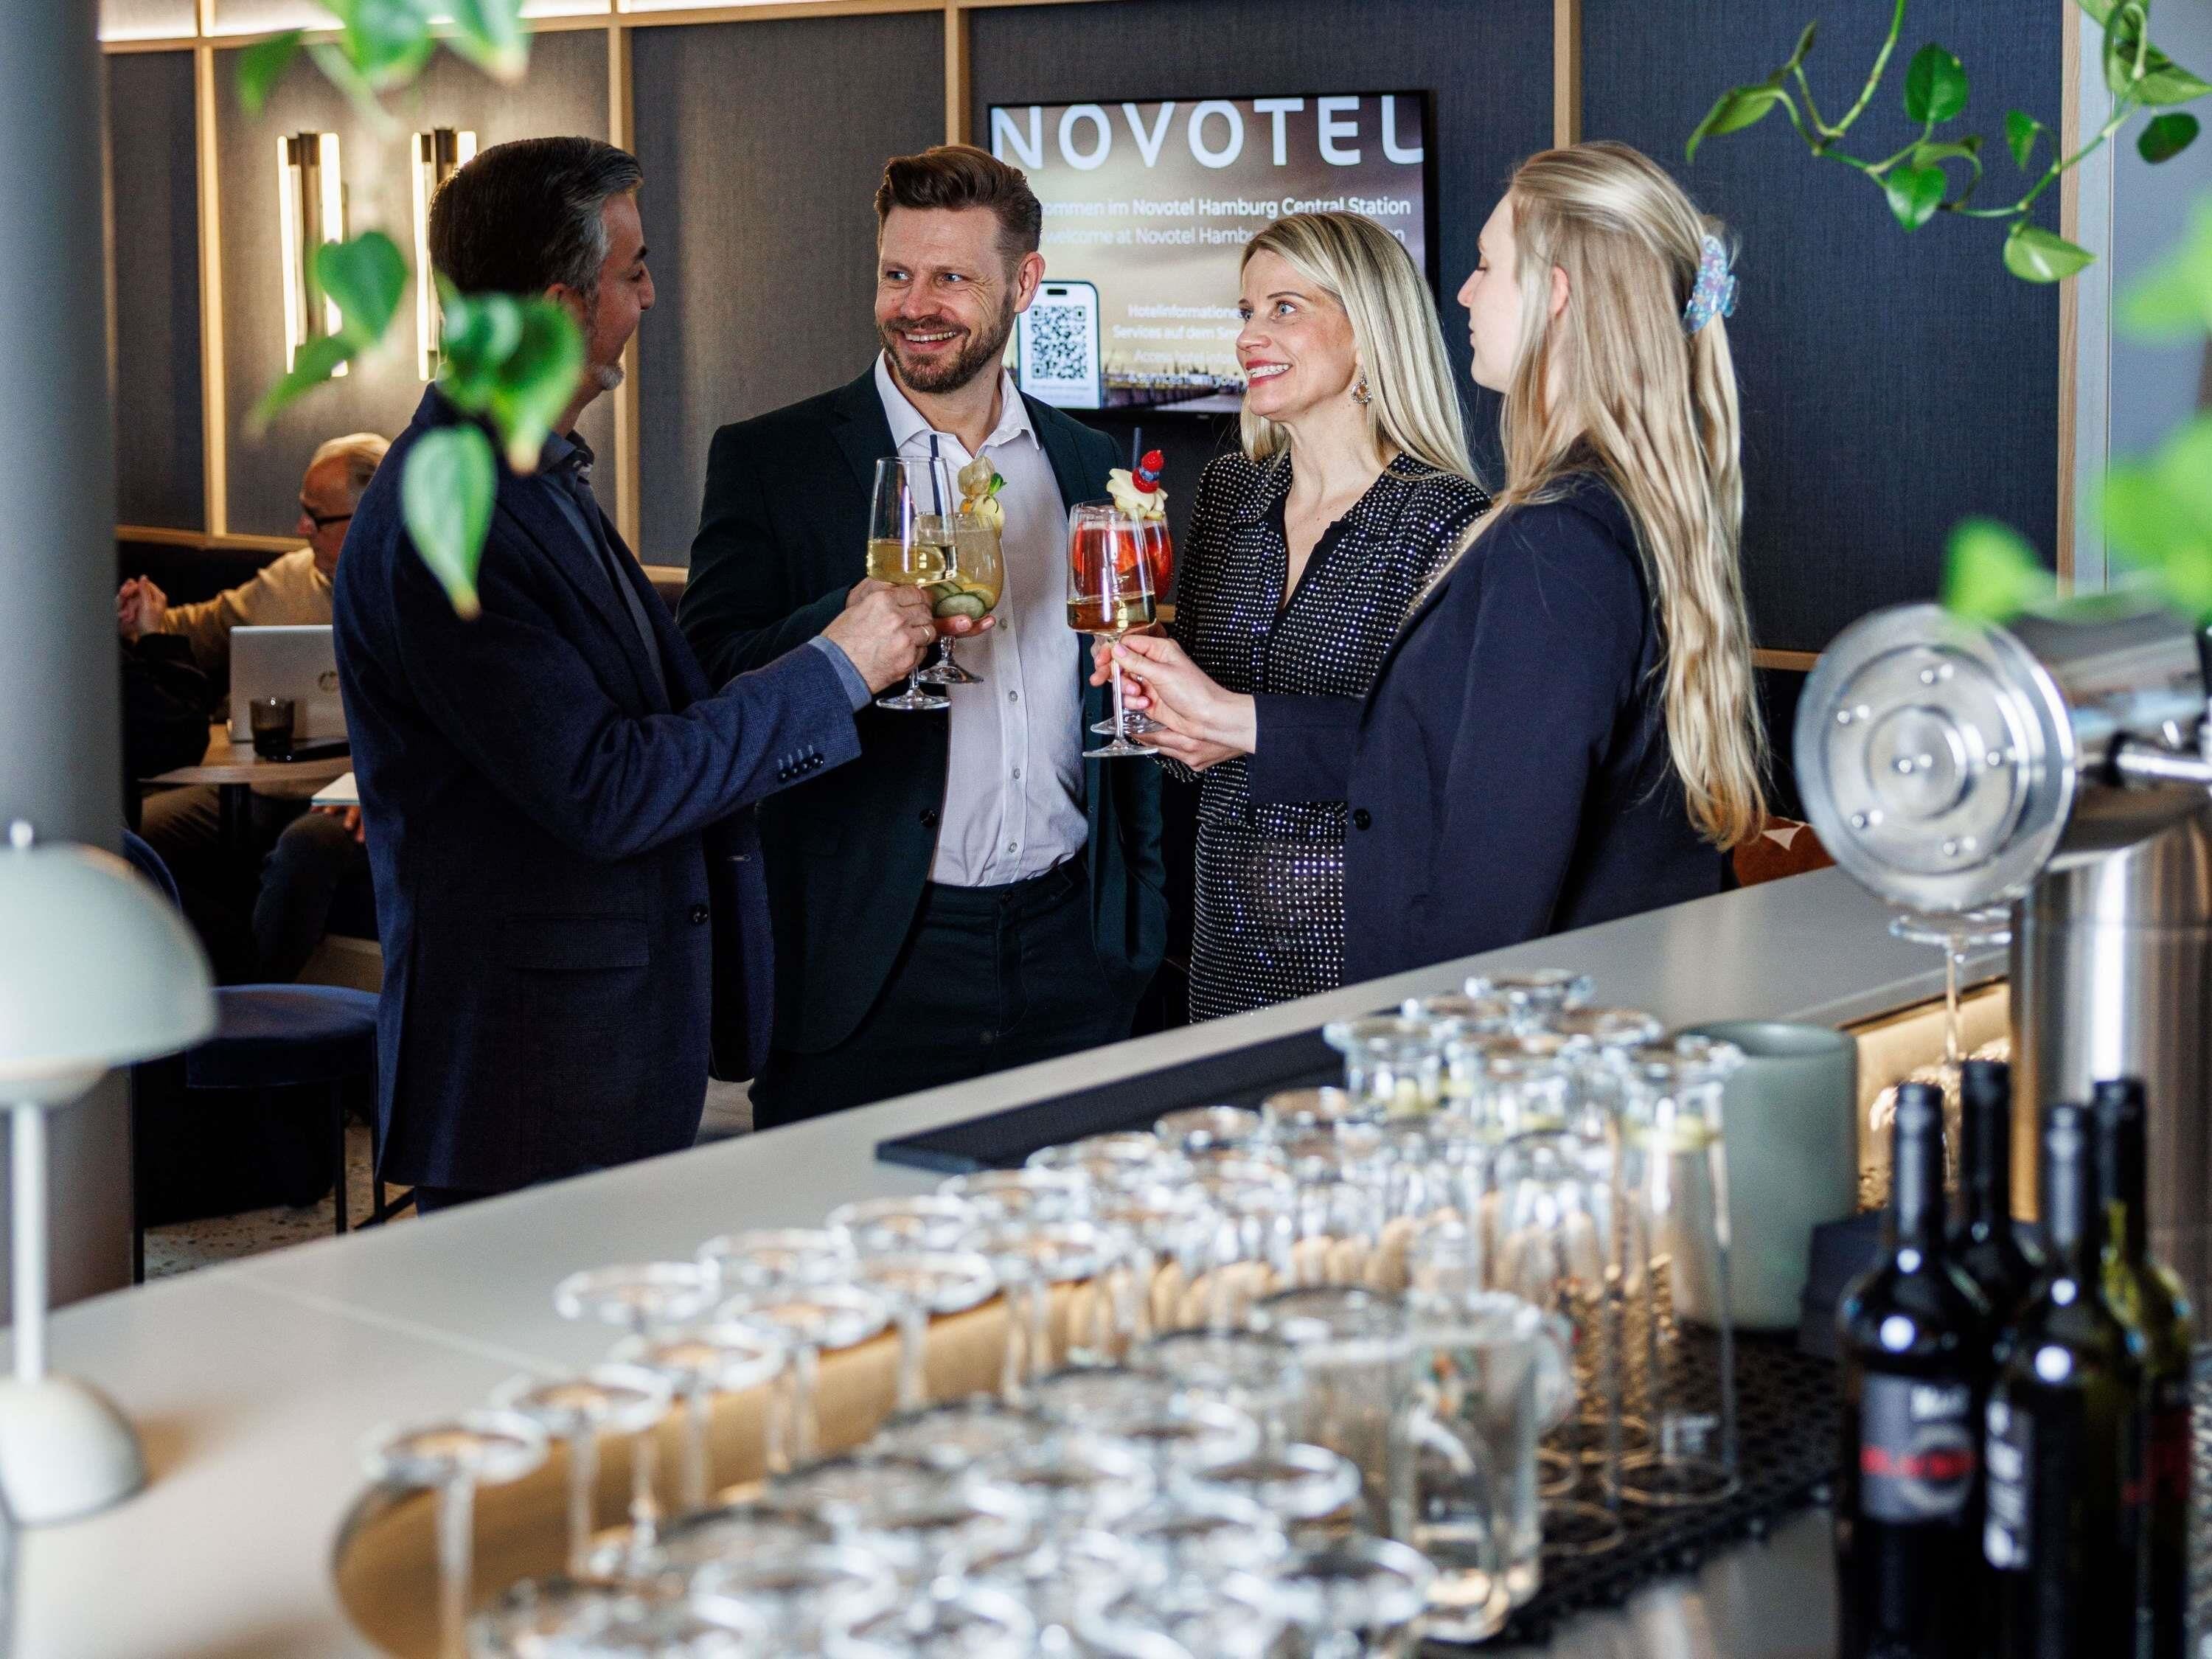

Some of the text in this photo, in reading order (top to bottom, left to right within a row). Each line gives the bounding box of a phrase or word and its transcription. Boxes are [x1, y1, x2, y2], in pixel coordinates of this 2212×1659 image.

[991, 95, 1424, 171] NOVOTEL
[1043, 195, 1411, 220] ommen im Novotel Hamburg Central Station
[1116, 229, 1133, 245] at
[1135, 226, 1195, 246] Novotel
[1127, 304, 1242, 319] Hotelinformatione
